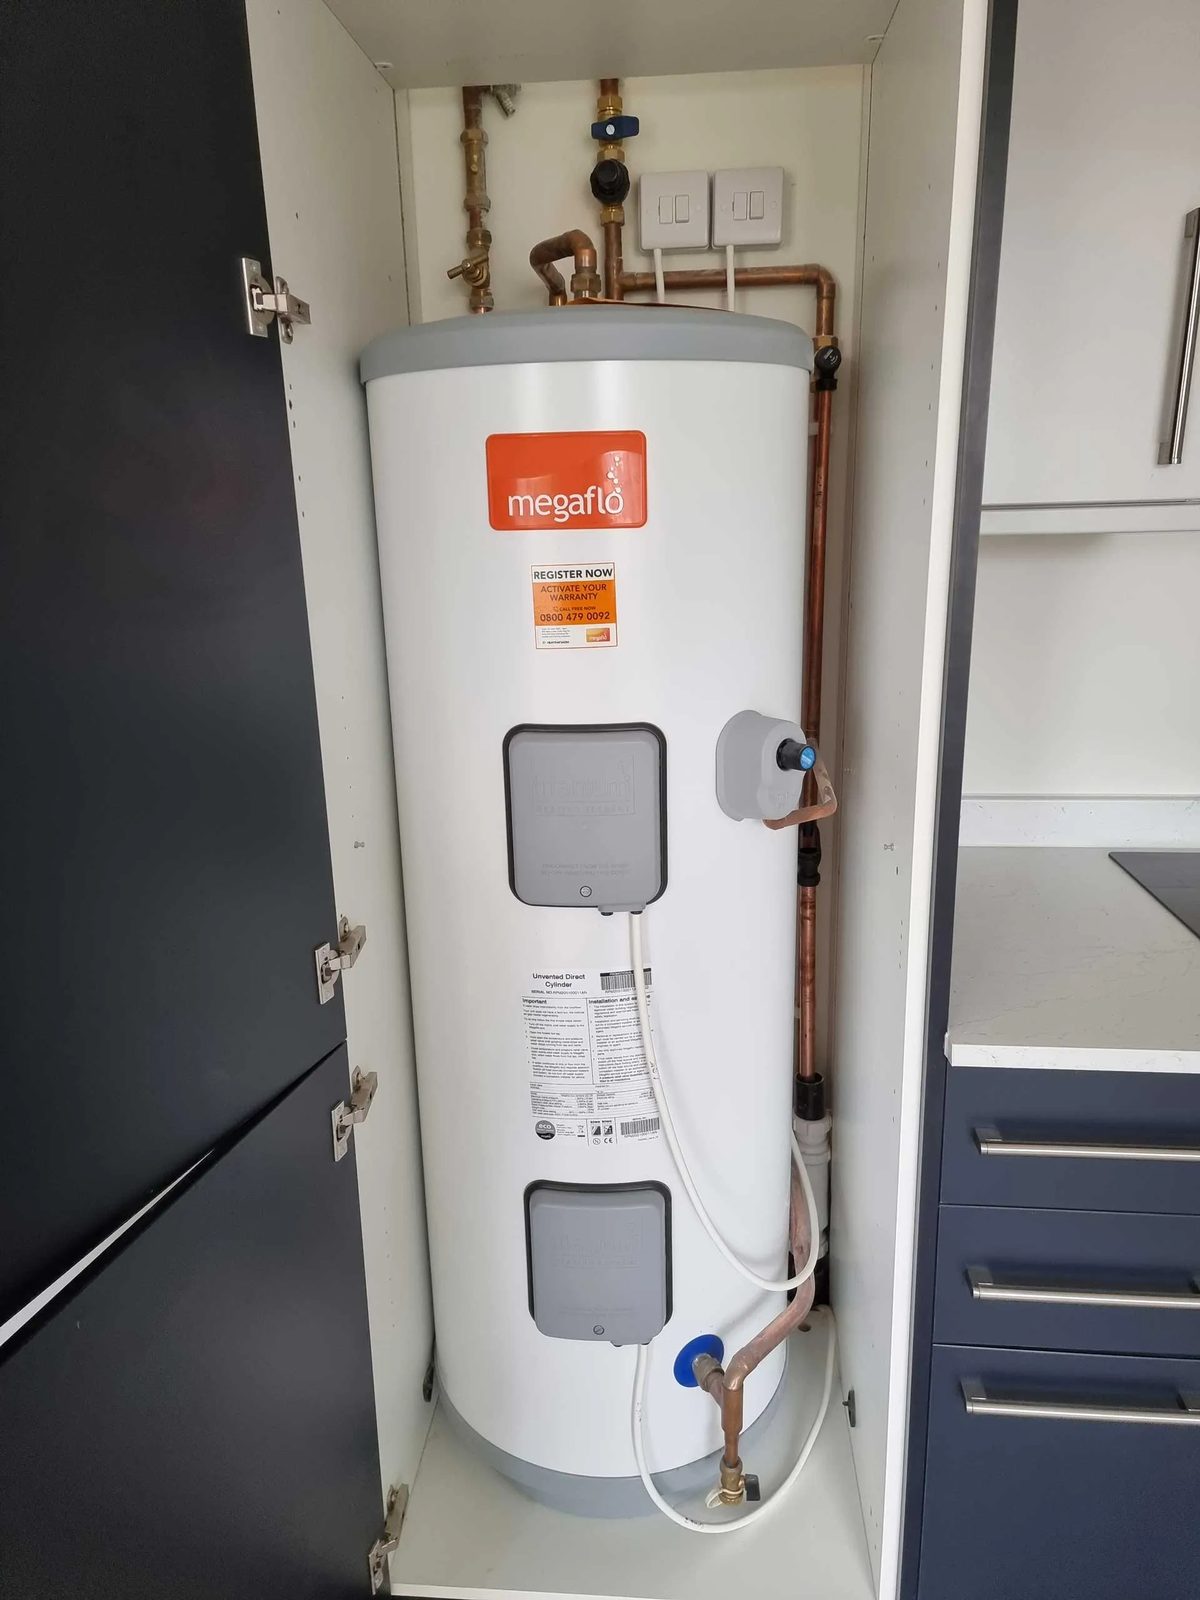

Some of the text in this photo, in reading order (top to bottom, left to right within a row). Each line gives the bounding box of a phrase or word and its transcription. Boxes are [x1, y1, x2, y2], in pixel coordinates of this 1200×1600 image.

[508, 485, 624, 522] megaflo
[534, 568, 613, 580] REGISTER NOW
[541, 583, 607, 593] ACTIVATE YOUR
[550, 592, 598, 601] WARRANTY
[540, 611, 610, 622] 0800 479 0092
